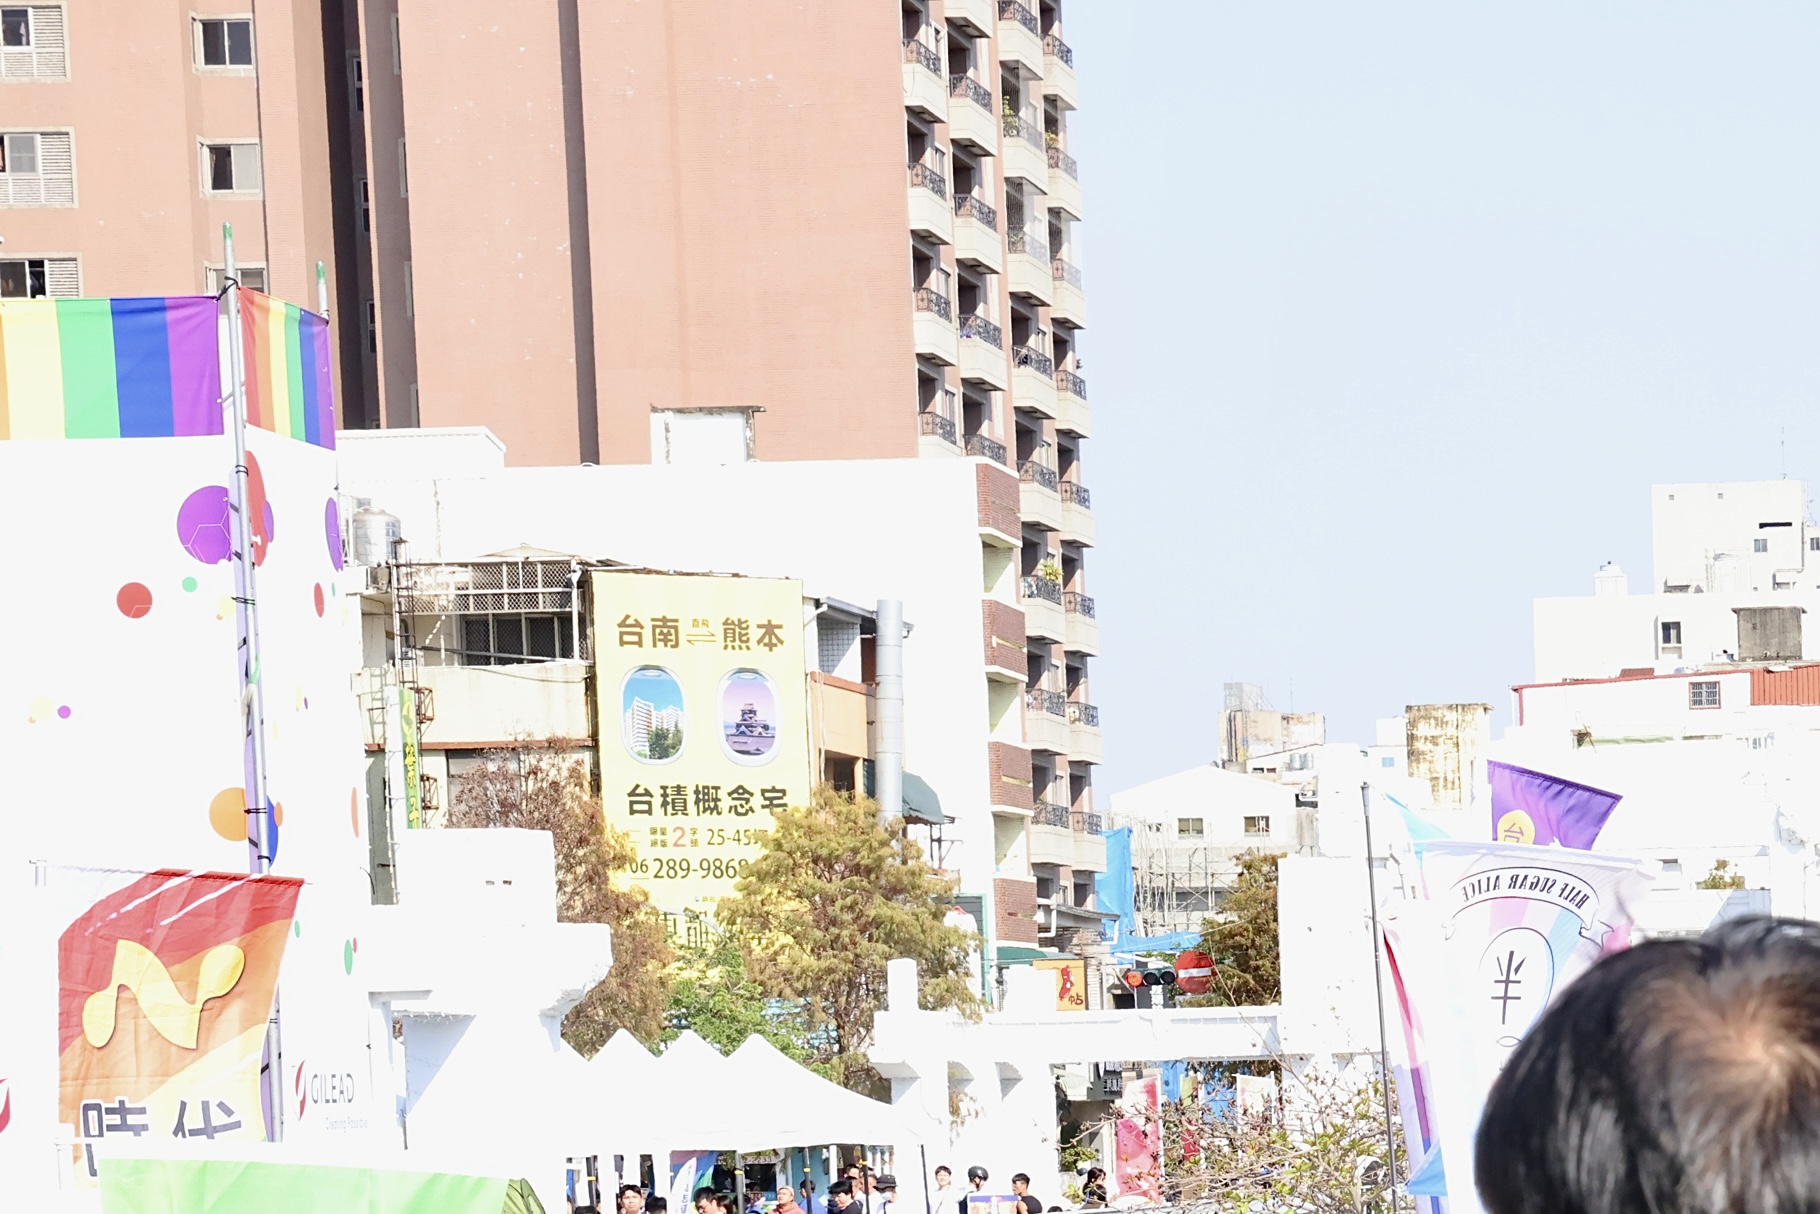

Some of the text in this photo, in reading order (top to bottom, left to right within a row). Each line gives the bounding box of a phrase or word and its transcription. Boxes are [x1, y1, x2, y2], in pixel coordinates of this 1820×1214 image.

[617, 614, 785, 652] 台南 熊本
[627, 783, 788, 817] 台積概念宅
[672, 826, 686, 847] 2
[311, 1072, 355, 1105] GILEAD
